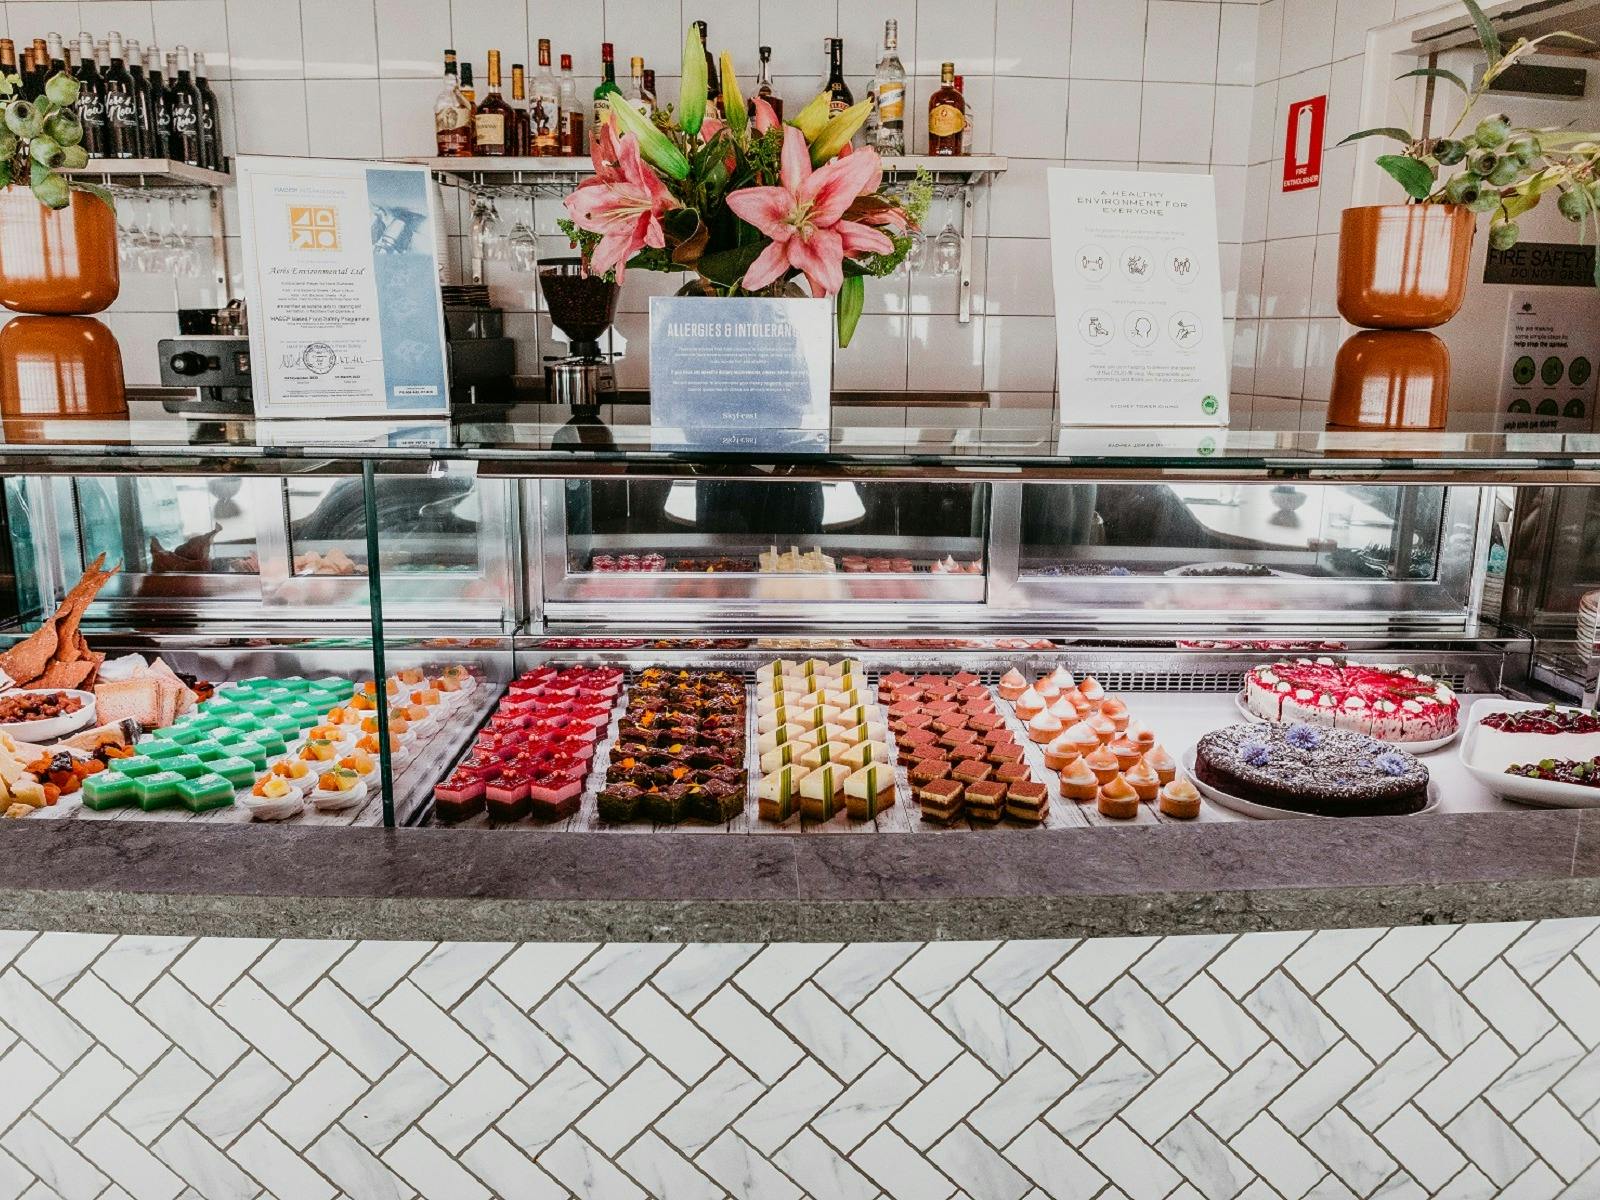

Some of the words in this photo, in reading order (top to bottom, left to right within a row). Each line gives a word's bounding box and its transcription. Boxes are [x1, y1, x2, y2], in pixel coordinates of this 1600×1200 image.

[1295, 167, 1308, 175] FIRE
[1112, 190, 1164, 198] HEALTHY
[1077, 197, 1161, 207] ENVIRONMENT
[1102, 207, 1164, 216] EVERYONE
[1489, 249, 1527, 266] FIRE
[1531, 250, 1593, 268] SAFETY
[1511, 268, 1528, 278] DO
[1532, 268, 1556, 279] NOT
[667, 323, 722, 338] ALLERGIES
[724, 323, 732, 338] &
[734, 323, 793, 338] INTOLERAN
